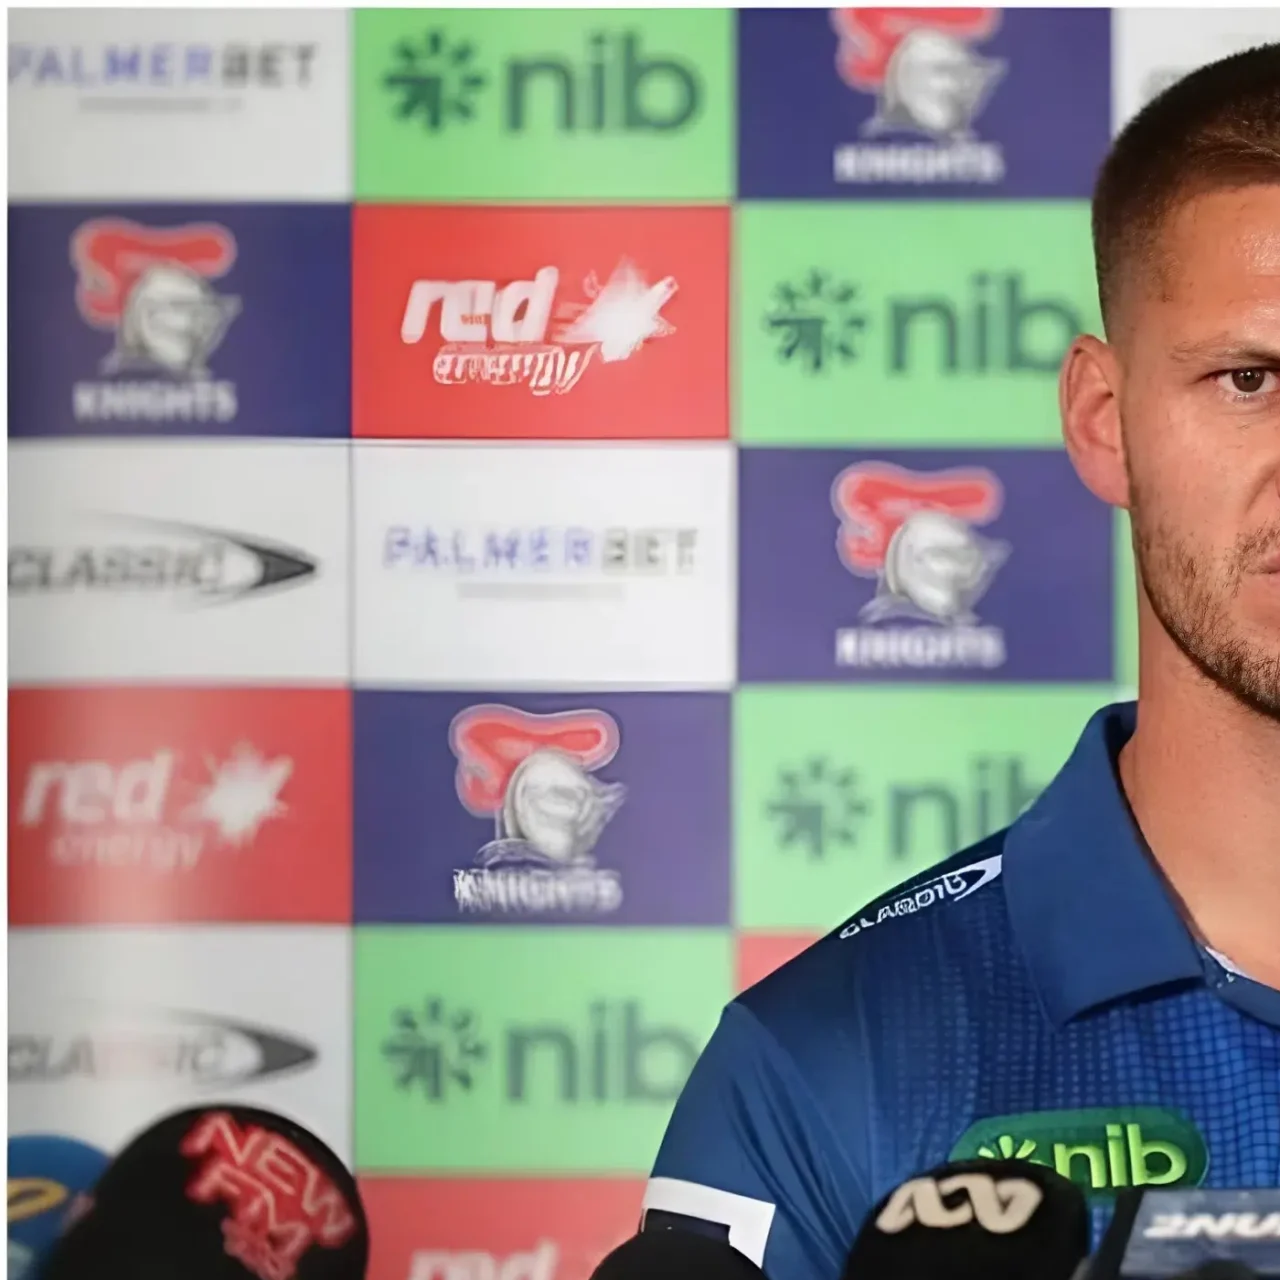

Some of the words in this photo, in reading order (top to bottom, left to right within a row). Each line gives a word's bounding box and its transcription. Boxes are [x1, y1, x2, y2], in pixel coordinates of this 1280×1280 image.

[507, 31, 701, 133] nib
[401, 267, 559, 343] red
[887, 270, 1083, 374] nib
[20, 747, 175, 826] red
[507, 1000, 699, 1101] nib
[1054, 1123, 1188, 1188] nib
